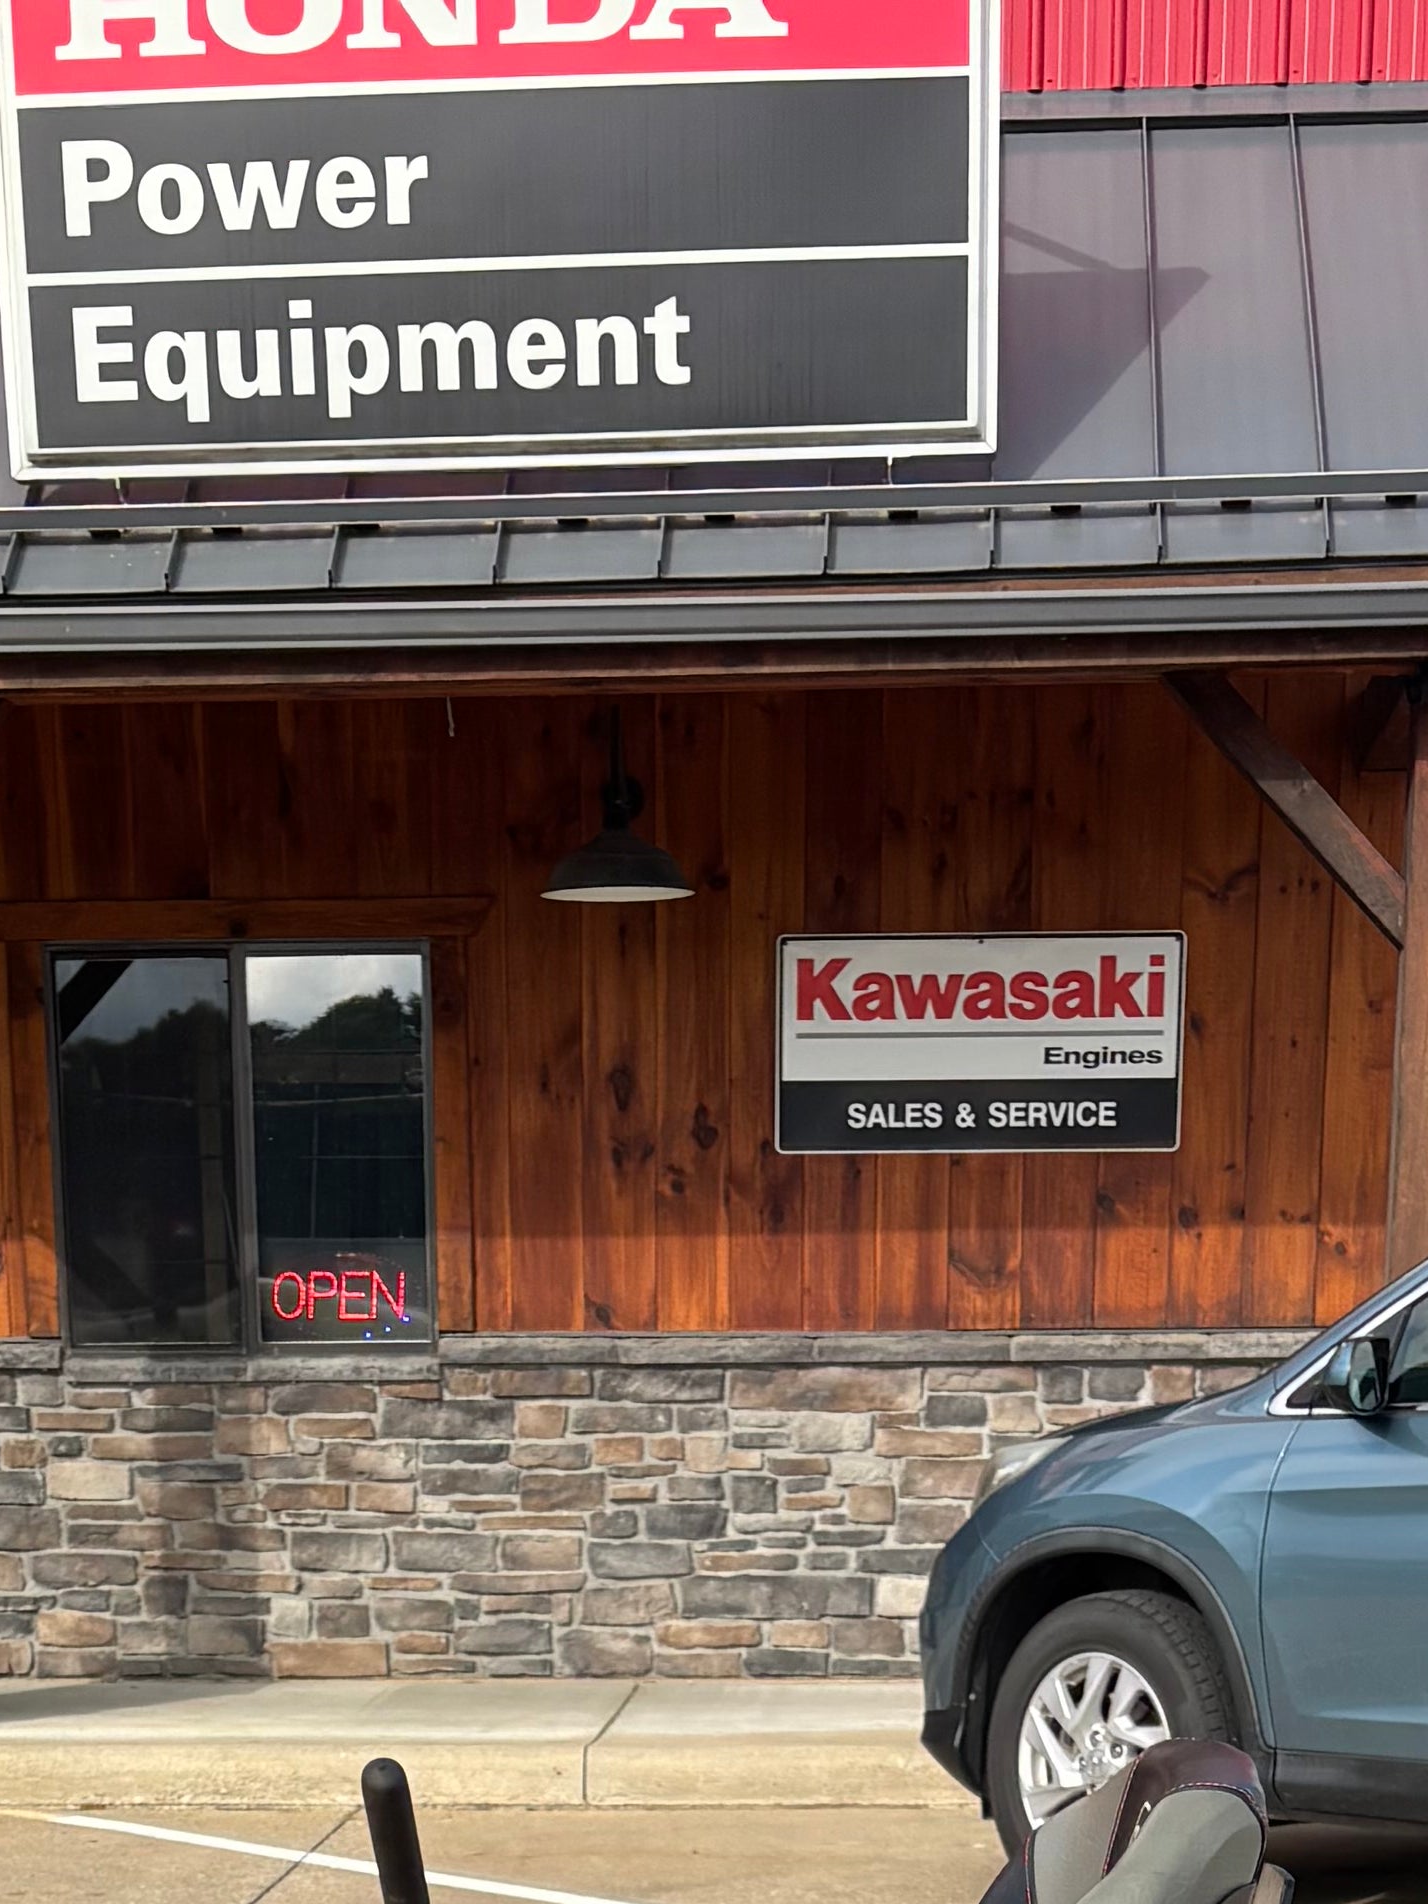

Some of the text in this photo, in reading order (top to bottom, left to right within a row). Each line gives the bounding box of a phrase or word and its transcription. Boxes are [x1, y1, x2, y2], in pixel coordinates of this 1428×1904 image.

[61, 138, 428, 238] Power
[72, 295, 691, 423] Equipment
[796, 955, 1166, 1021] Kawasaki
[1043, 1047, 1164, 1069] Engines
[847, 1102, 1117, 1129] SALES & SERVICE
[272, 1271, 406, 1321] OPEN
